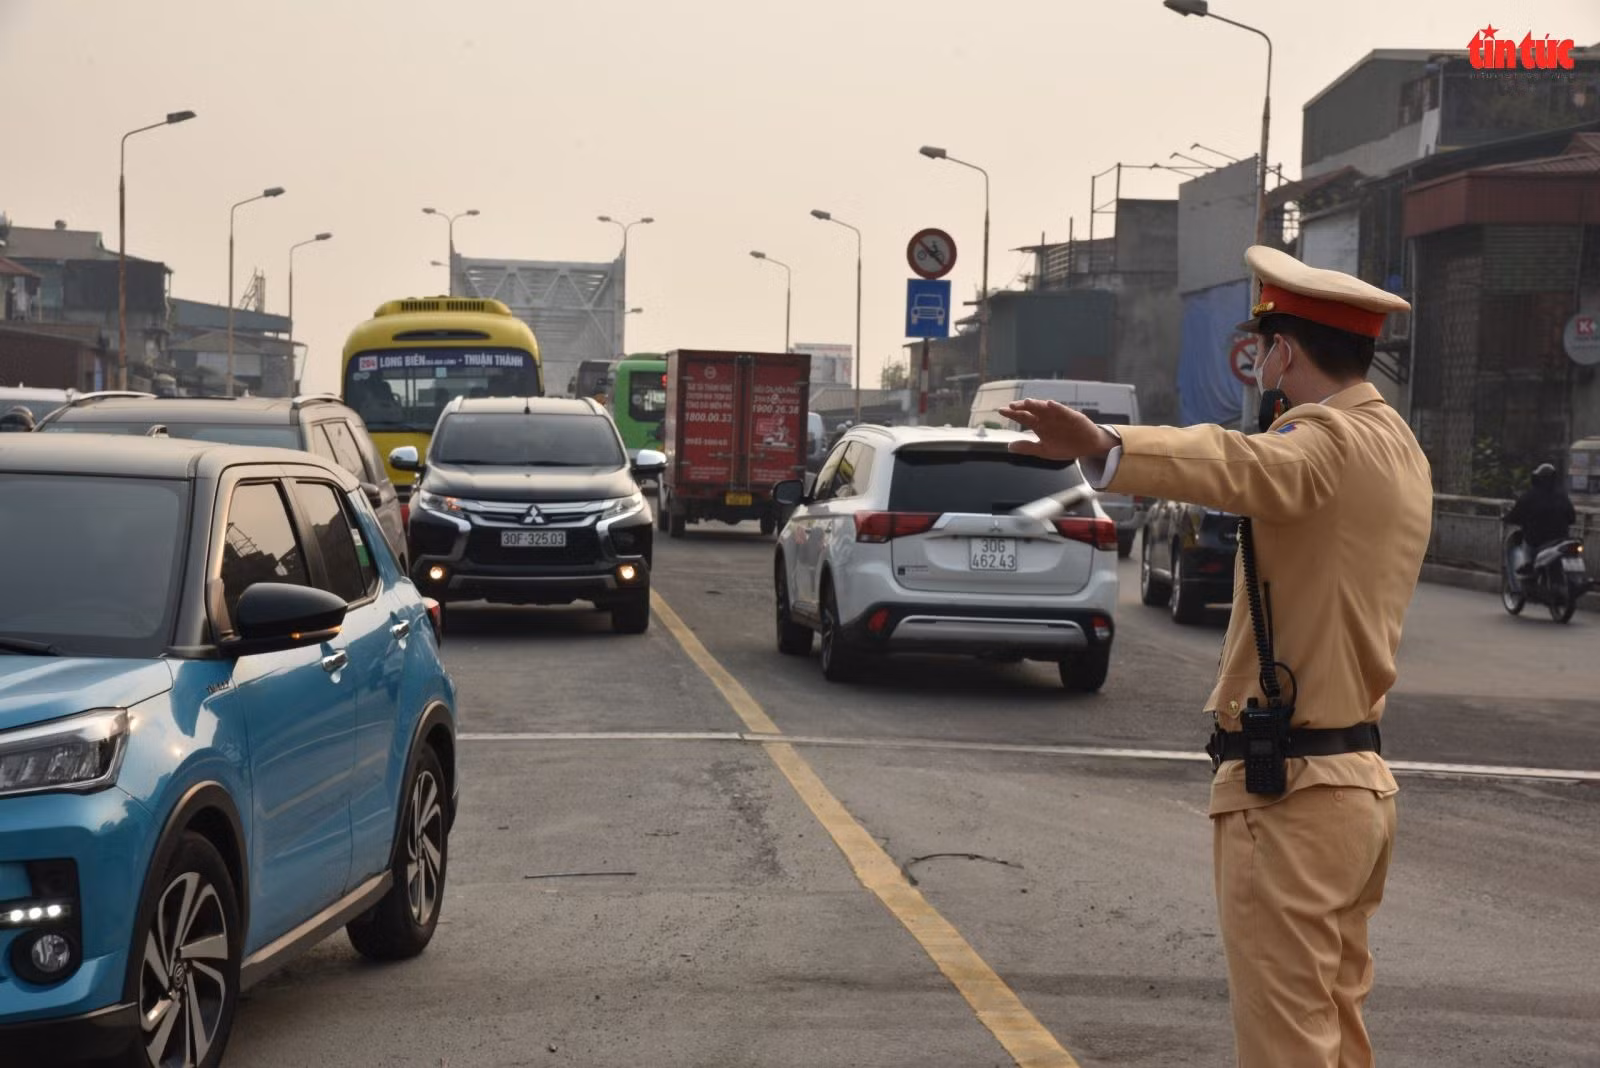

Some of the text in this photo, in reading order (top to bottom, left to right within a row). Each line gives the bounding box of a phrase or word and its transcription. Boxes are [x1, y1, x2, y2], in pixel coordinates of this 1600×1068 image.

[380, 356, 403, 368] LONG
[464, 352, 493, 368] THUẬN
[495, 354, 523, 367] THÀNH
[981, 539, 1006, 553] 30G
[972, 554, 1015, 569] 462.43
